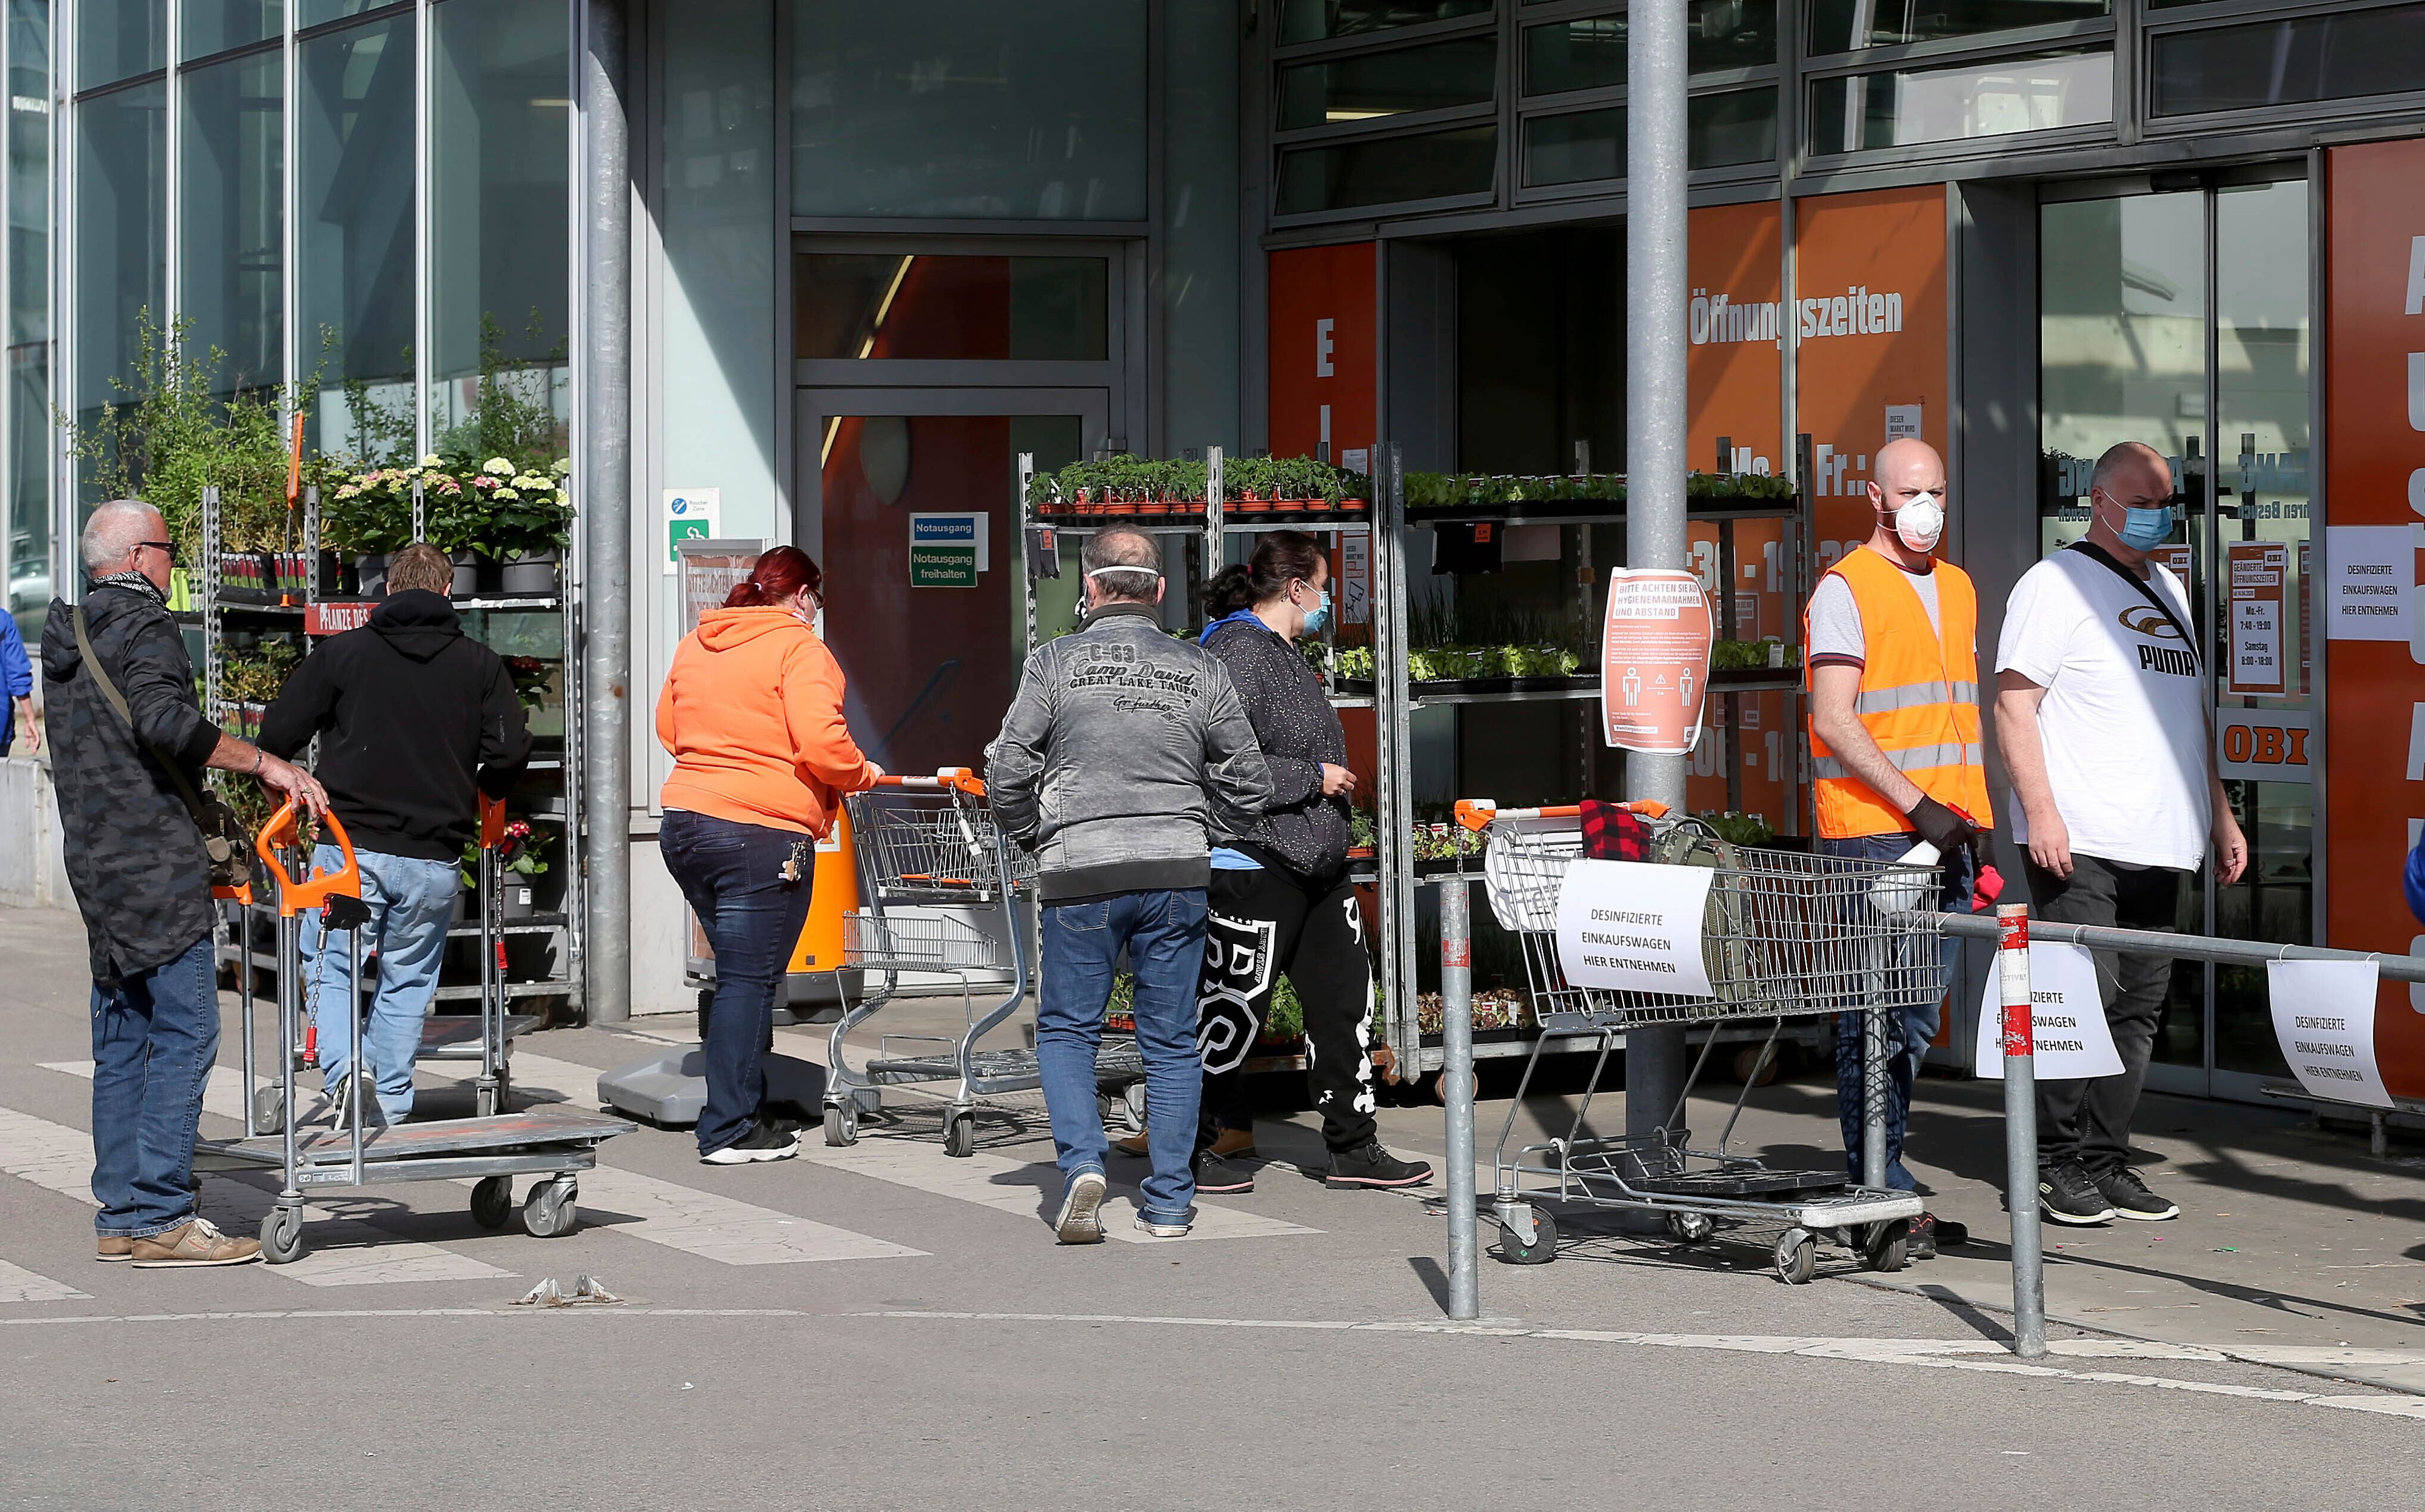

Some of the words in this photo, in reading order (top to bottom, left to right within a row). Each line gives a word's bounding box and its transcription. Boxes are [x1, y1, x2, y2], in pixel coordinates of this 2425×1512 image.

[916, 524, 972, 534] Notausgang
[913, 554, 973, 566] Notausgang
[2233, 561, 2263, 572] GEÄNDERTE
[2347, 565, 2392, 575] DESINFIZIERTE
[921, 569, 966, 578] freihalten
[1619, 584, 1639, 594] BITTE
[1642, 584, 1676, 593] ACHTEN
[1678, 584, 1688, 593] SIE
[2343, 585, 2398, 595] EINKAUFSWAGEN
[1616, 608, 1632, 617] UND
[1635, 608, 1676, 617] ABSTAND
[2342, 606, 2356, 615] HIER
[2358, 606, 2398, 615] ENTNEHMEN
[2240, 621, 2252, 630] 7:40
[2256, 621, 2271, 630] 19:00
[2245, 641, 2268, 653] Samstag
[2137, 644, 2196, 677] PUMA
[2241, 656, 2253, 665] 8:00
[2258, 656, 2273, 666] 18:00
[1073, 658, 1128, 678] Camp
[1130, 660, 1195, 686] David
[1070, 675, 1112, 689] GREAT
[1119, 677, 1154, 689] LAKE
[1159, 680, 1199, 697] TAUPO
[2224, 724, 2309, 766] OBI
[1591, 909, 1663, 926] DESINFIZIERTE
[1582, 932, 1671, 951] EINKAUFSWAGEN
[1584, 955, 1608, 967] HIER
[1610, 957, 1676, 973] ENTNEHMEN
[2031, 991, 2064, 1003] IZIERTE
[2295, 1016, 2345, 1031] DESINFIZIERTE
[2295, 1041, 2355, 1057] EINKAUFSWAGEN
[2303, 1065, 2322, 1077] HIER
[2320, 1067, 2364, 1082] ENTNEHMEN
